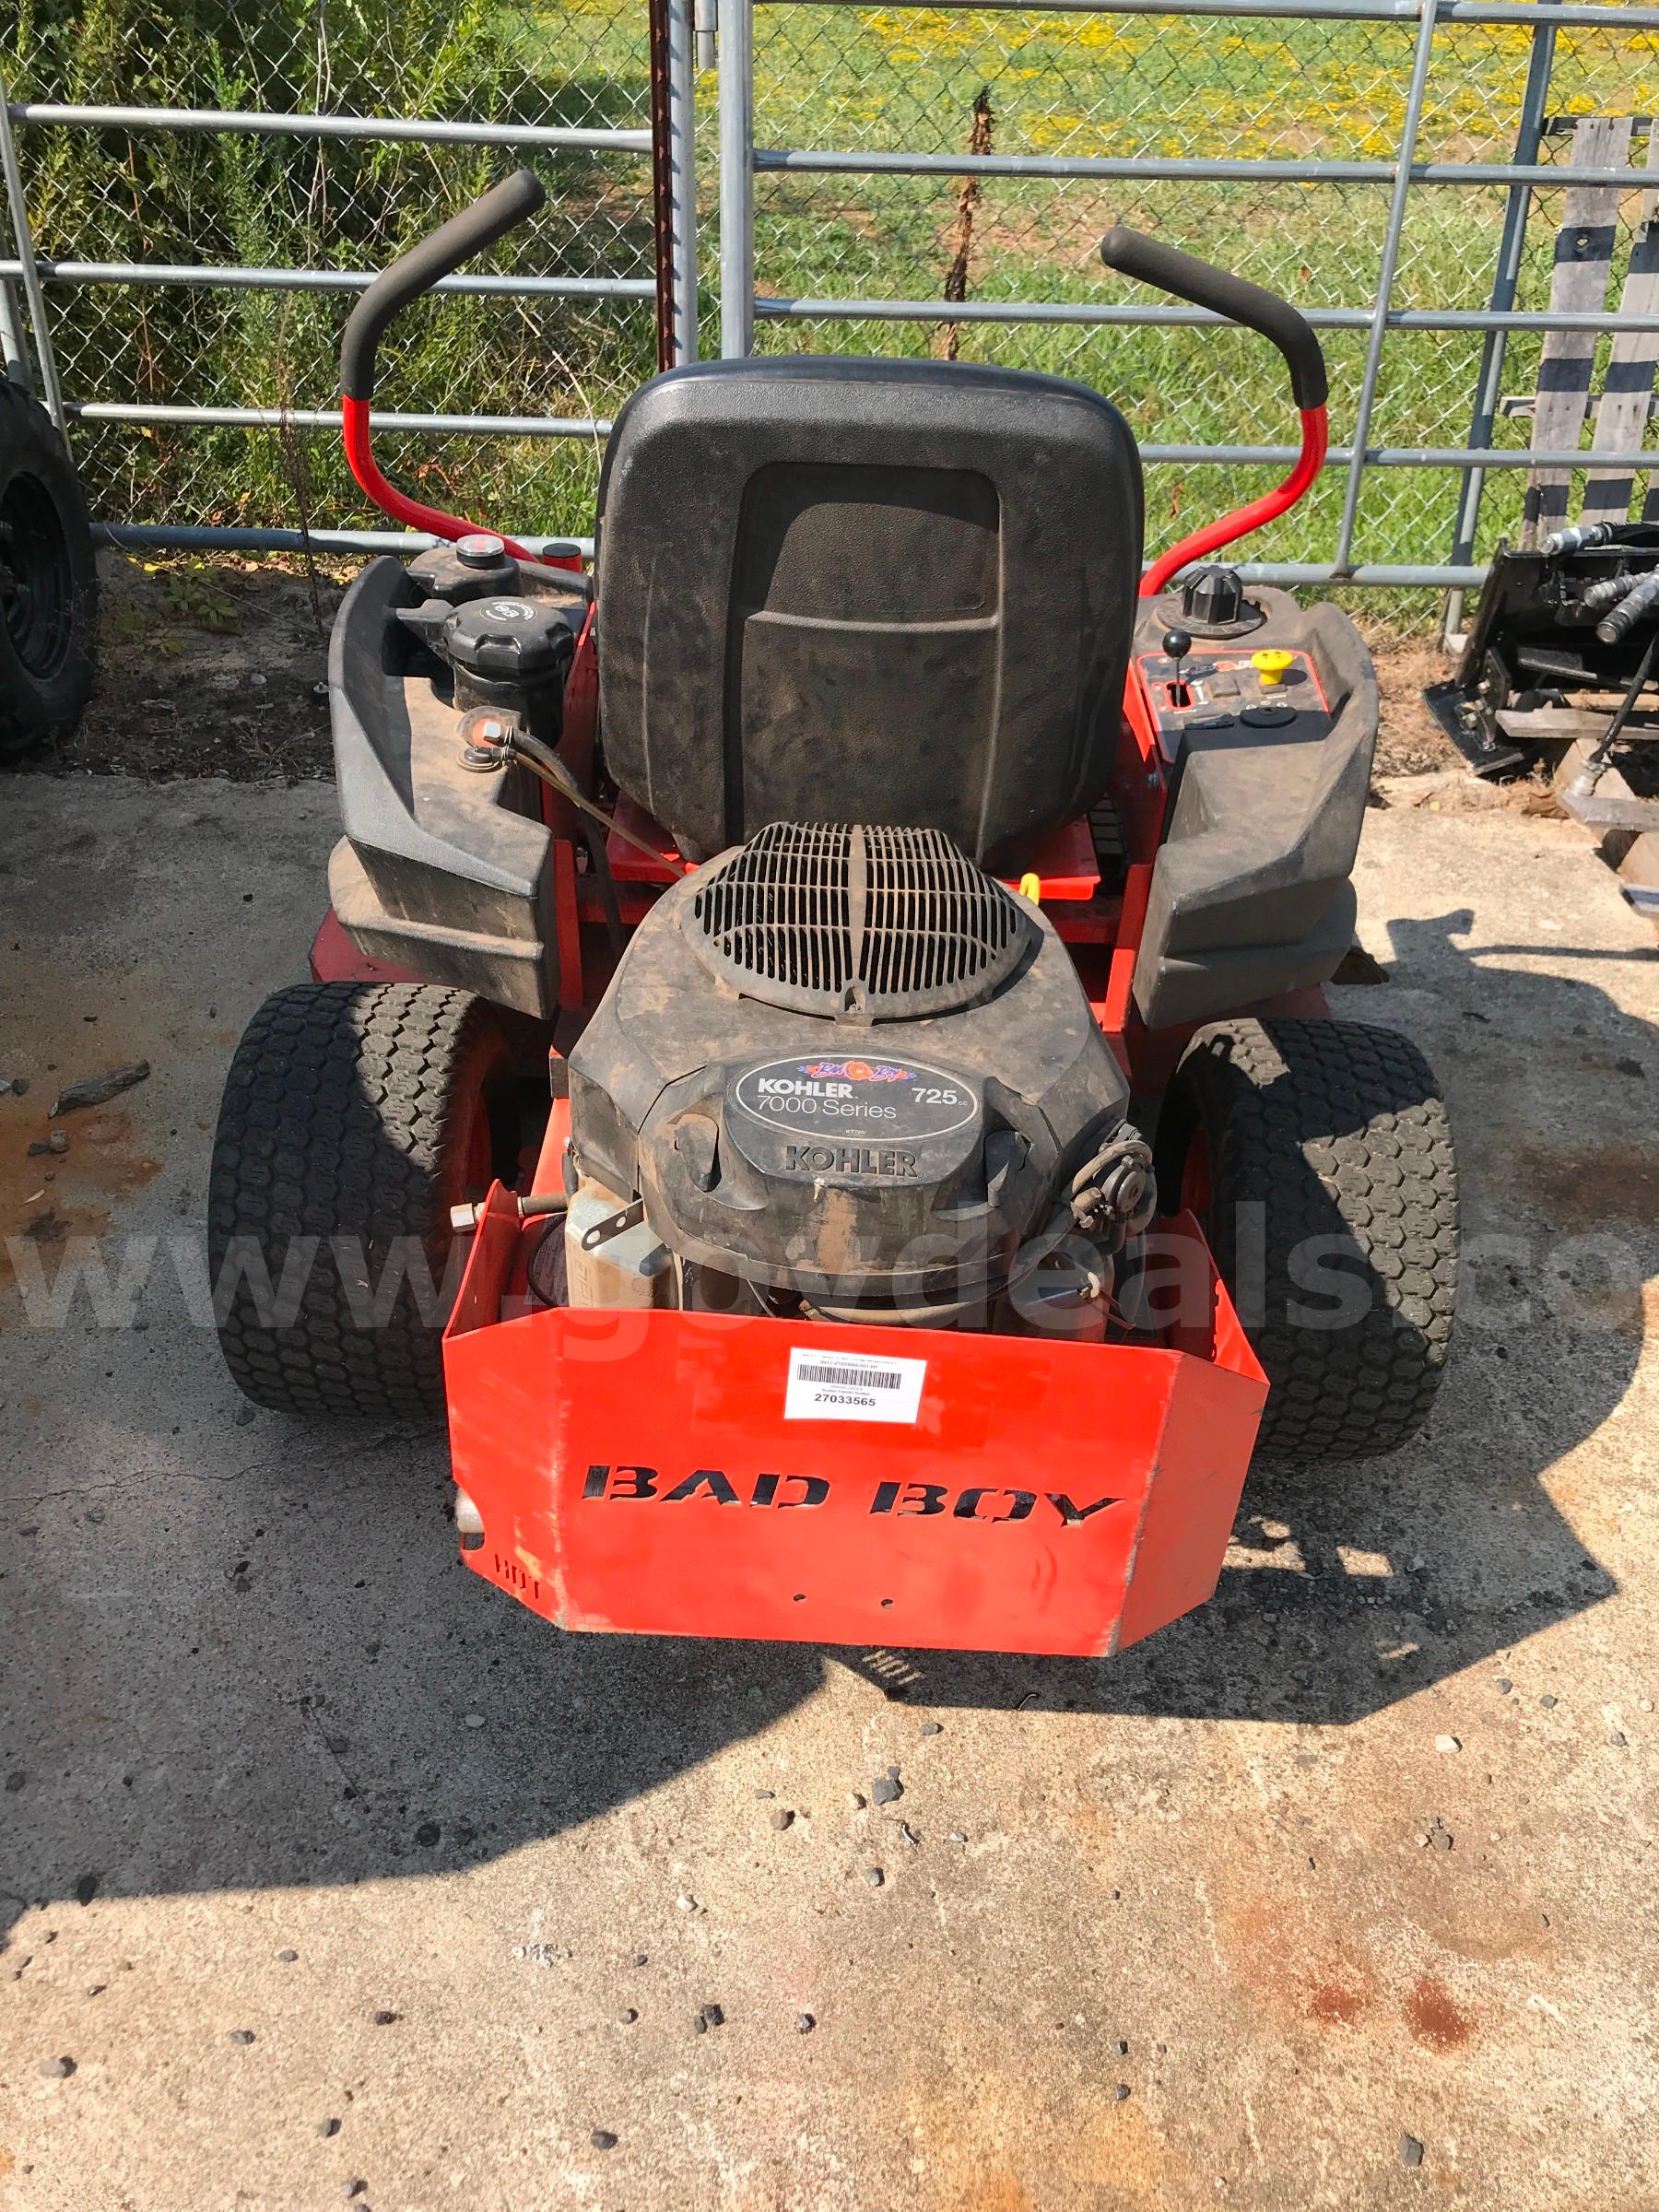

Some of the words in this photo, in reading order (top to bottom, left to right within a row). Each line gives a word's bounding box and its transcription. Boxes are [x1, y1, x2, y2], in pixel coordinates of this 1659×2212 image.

[757, 1077, 853, 1100] KOHLER
[757, 1094, 818, 1114] 7000
[821, 1100, 897, 1119] Series
[786, 1146, 918, 1177] KOHLER
[815, 1394, 876, 1406] 27033565
[582, 1465, 830, 1509] BAD
[869, 1481, 1127, 1527] BOY
